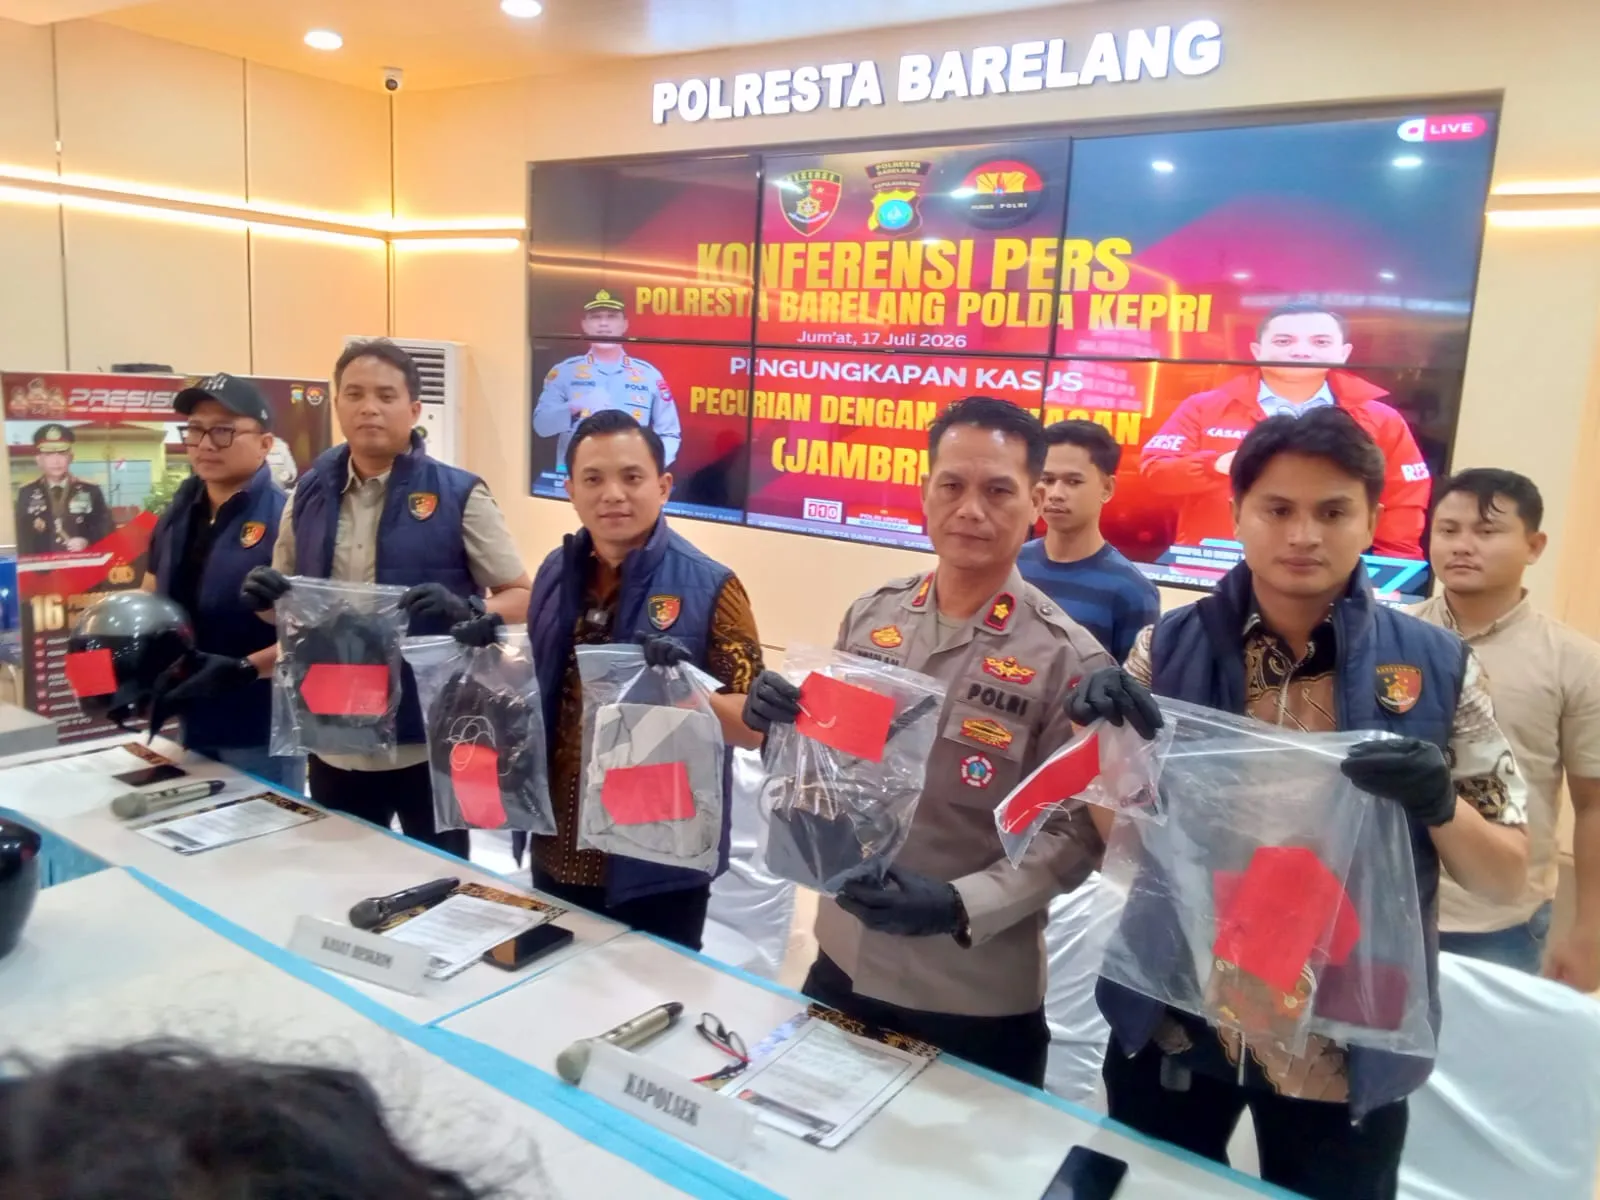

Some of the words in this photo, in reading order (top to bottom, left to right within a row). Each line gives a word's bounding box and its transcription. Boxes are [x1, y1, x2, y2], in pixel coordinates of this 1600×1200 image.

[652, 60, 884, 125] POLRESTA
[897, 20, 1222, 102] BARELANG
[1429, 121, 1473, 135] LIVE
[875, 160, 921, 171] POLRESTA
[696, 239, 974, 290] KONFERENSI
[991, 237, 1132, 292] PERS
[635, 286, 769, 322] POLRESTA
[779, 291, 945, 327] BARELANG
[957, 291, 1074, 331] POLDA
[1088, 293, 1213, 333] KEPRI
[796, 330, 857, 346] Jum'at,
[861, 332, 880, 345] 17
[883, 333, 916, 347] Juli
[919, 334, 968, 348] 2026
[975, 368, 1084, 392] KASUS
[690, 386, 812, 422] PECURIAN
[820, 394, 937, 431] DENGAN
[808, 502, 838, 520] 110
[30, 593, 65, 633] 16
[966, 683, 1029, 717] POLRI
[623, 1072, 702, 1127] KAPOLSEK
